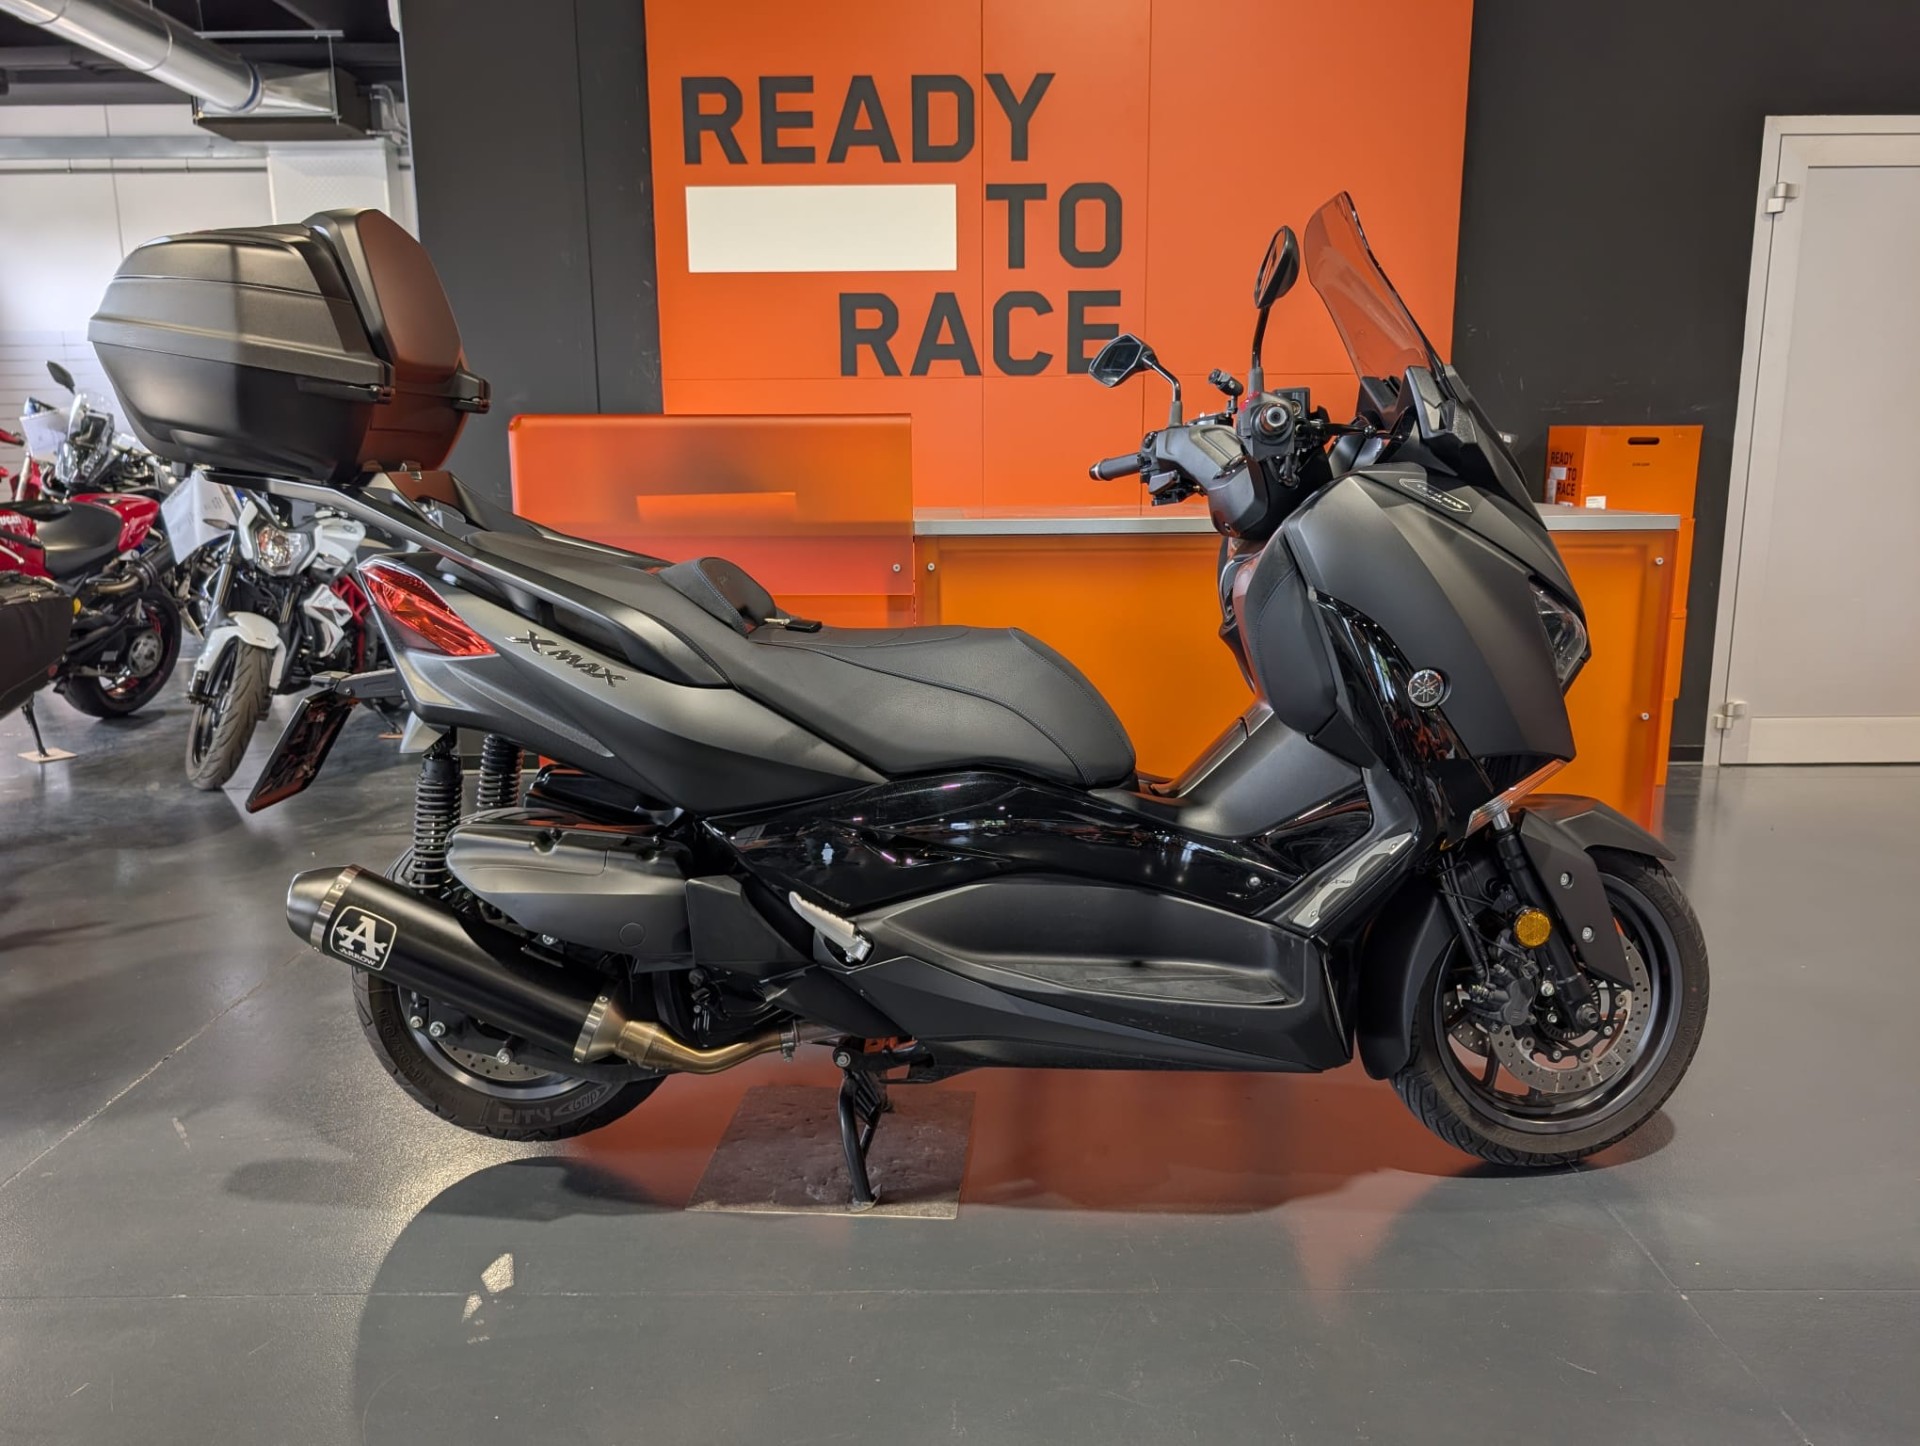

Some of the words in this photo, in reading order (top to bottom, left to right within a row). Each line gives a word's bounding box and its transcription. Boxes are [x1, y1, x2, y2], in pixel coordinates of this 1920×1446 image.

[681, 73, 1056, 164] READY
[986, 182, 1122, 270] TO
[839, 290, 1121, 377] RACE
[1550, 451, 1574, 465] READY
[1567, 467, 1577, 481] TO
[1556, 482, 1576, 497] RACE
[339, 948, 376, 966] ARROW
[498, 1107, 552, 1125] CITY
